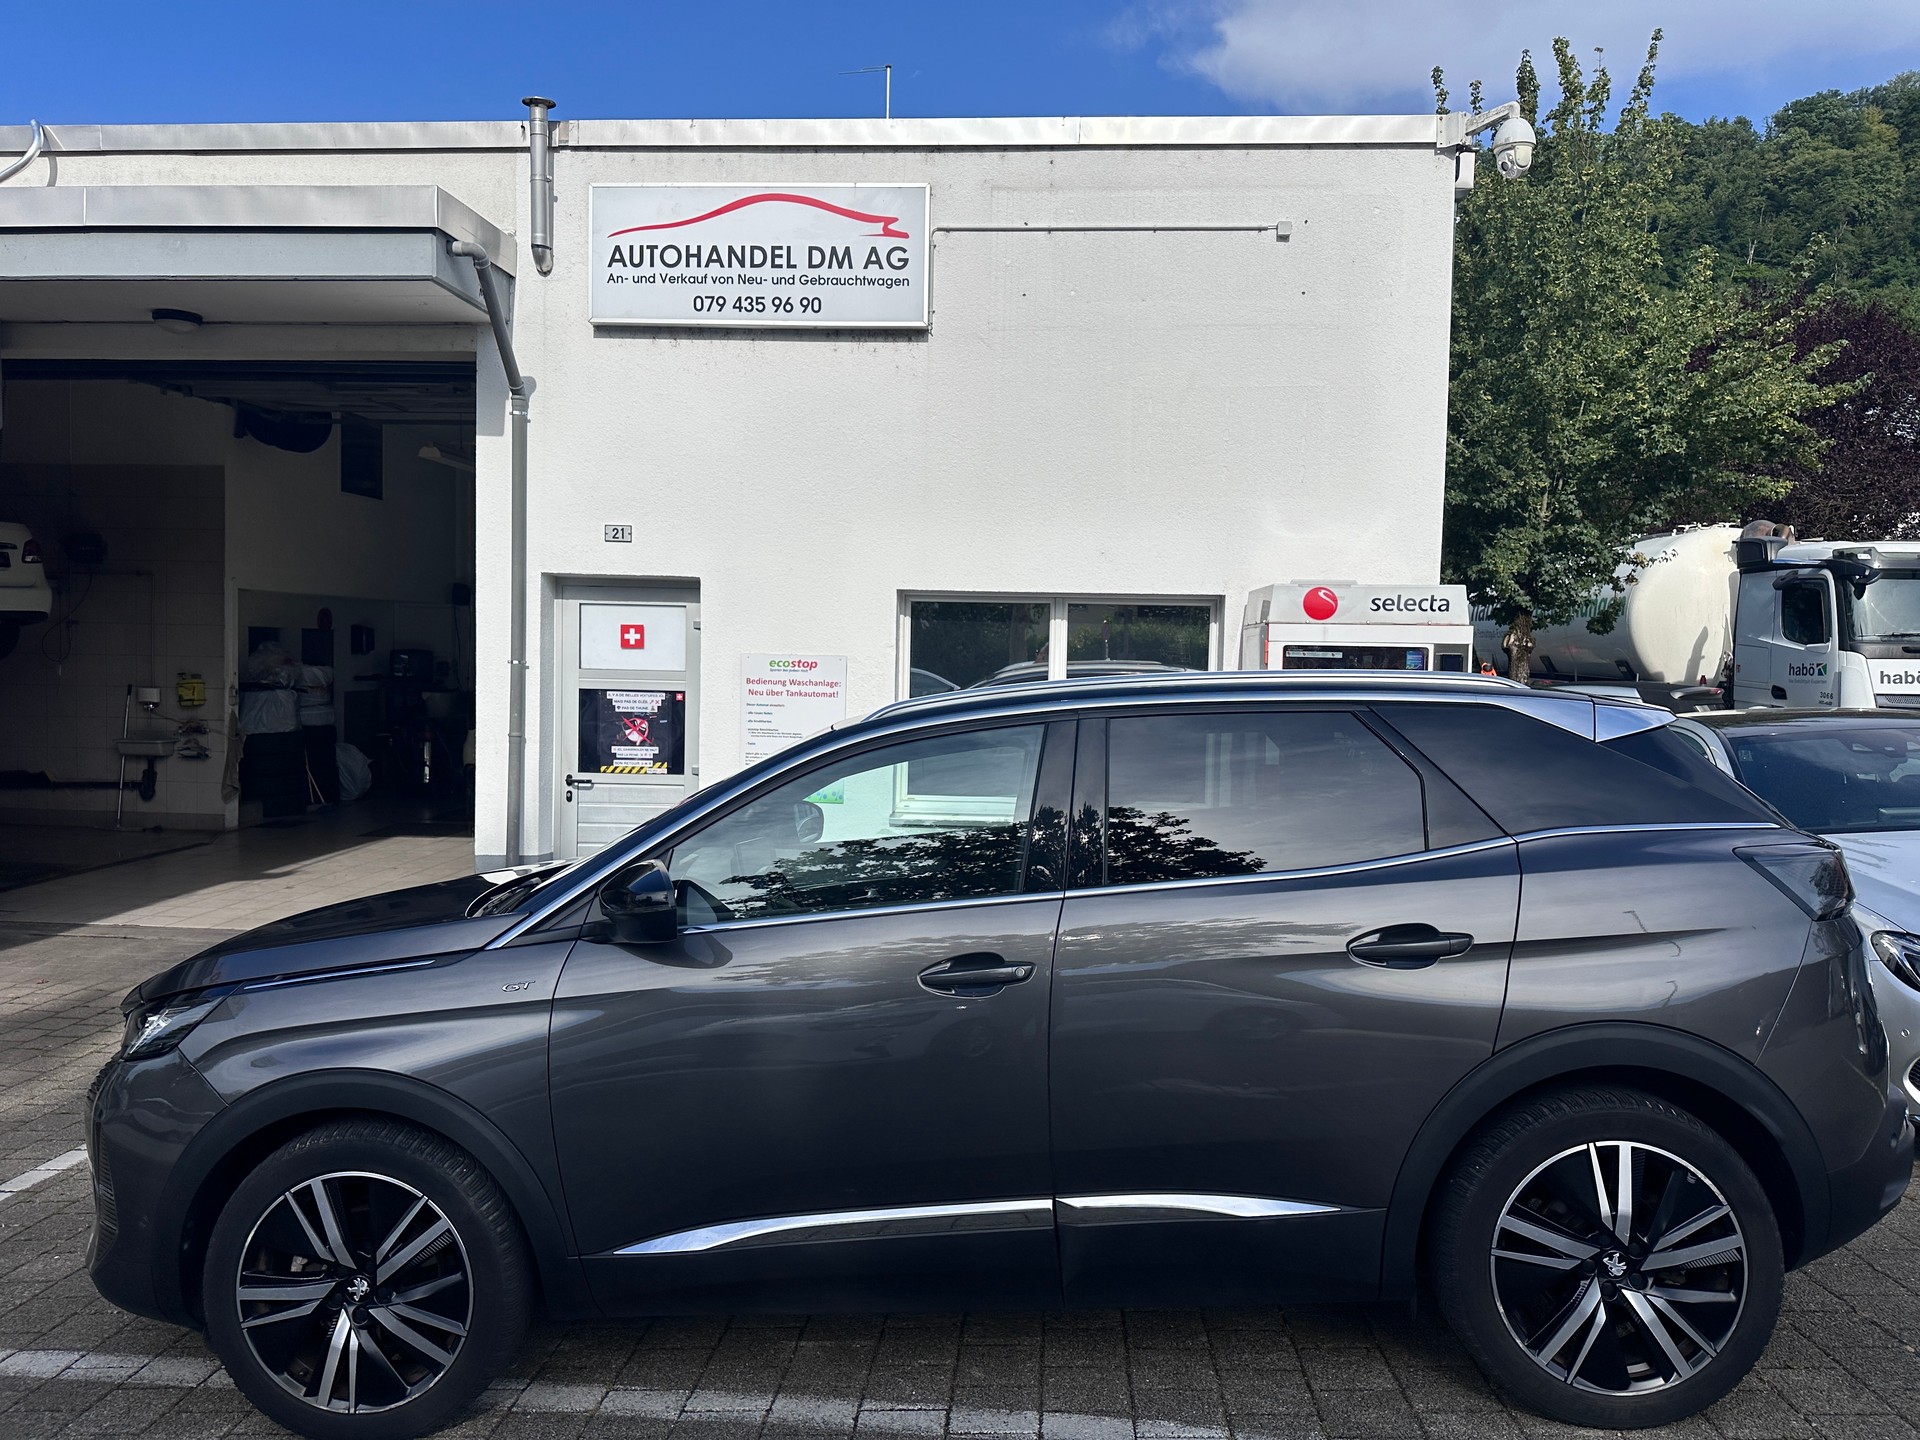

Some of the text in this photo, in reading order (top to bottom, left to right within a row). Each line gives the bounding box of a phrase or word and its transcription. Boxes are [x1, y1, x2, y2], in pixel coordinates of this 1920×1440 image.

[607, 244, 910, 271] AUTOHANDEL DM AG
[607, 273, 910, 289] An- und Verkauf von Neu- und Gebrauchtwagen
[693, 295, 823, 314] 079 435 96 90
[612, 527, 625, 540] 21
[1369, 594, 1450, 613] selecta
[768, 658, 818, 671] ecostop
[1788, 662, 1815, 677] habö
[746, 677, 842, 689] Bedienung Waschanlage:
[748, 688, 839, 699] Neu über Tankautomat!
[1819, 691, 1834, 700] 3066
[501, 980, 536, 993] GT
